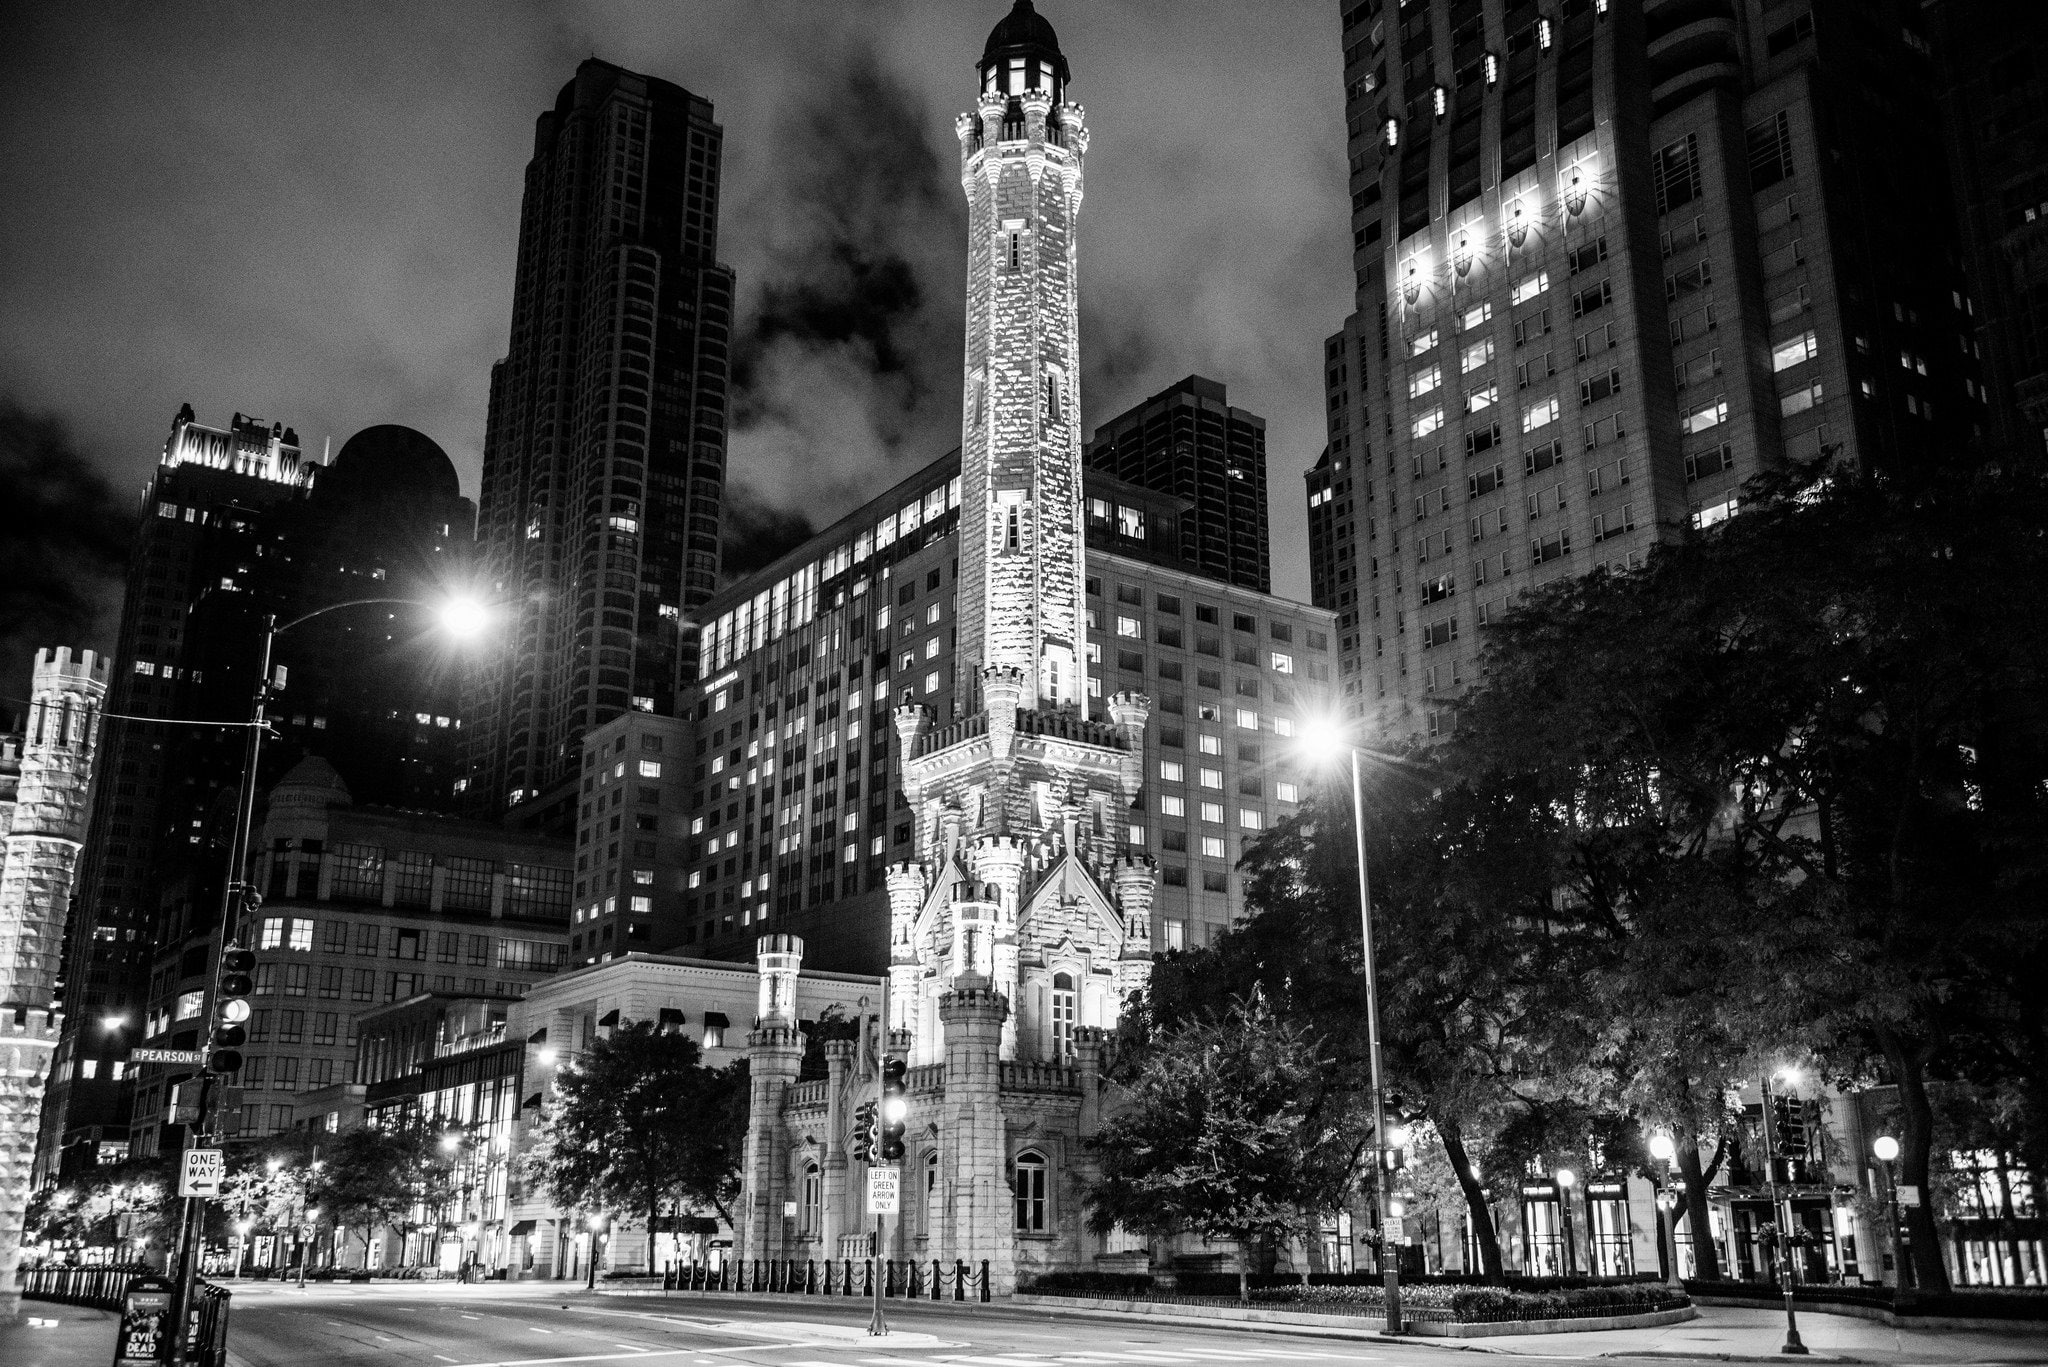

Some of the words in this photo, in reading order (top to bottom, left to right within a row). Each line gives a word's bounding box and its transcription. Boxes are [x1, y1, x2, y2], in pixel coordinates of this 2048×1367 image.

[141, 1050, 193, 1062] PEARSON
[190, 1154, 216, 1164] ONE
[189, 1167, 216, 1177] WAY
[871, 1171, 886, 1180] LEFT
[888, 1171, 898, 1180] ON
[873, 1181, 895, 1190] GREEN
[872, 1191, 895, 1199] ARROW
[875, 1200, 891, 1209] ONLY
[130, 1332, 155, 1343] EVIL
[126, 1342, 156, 1353] DEAD
